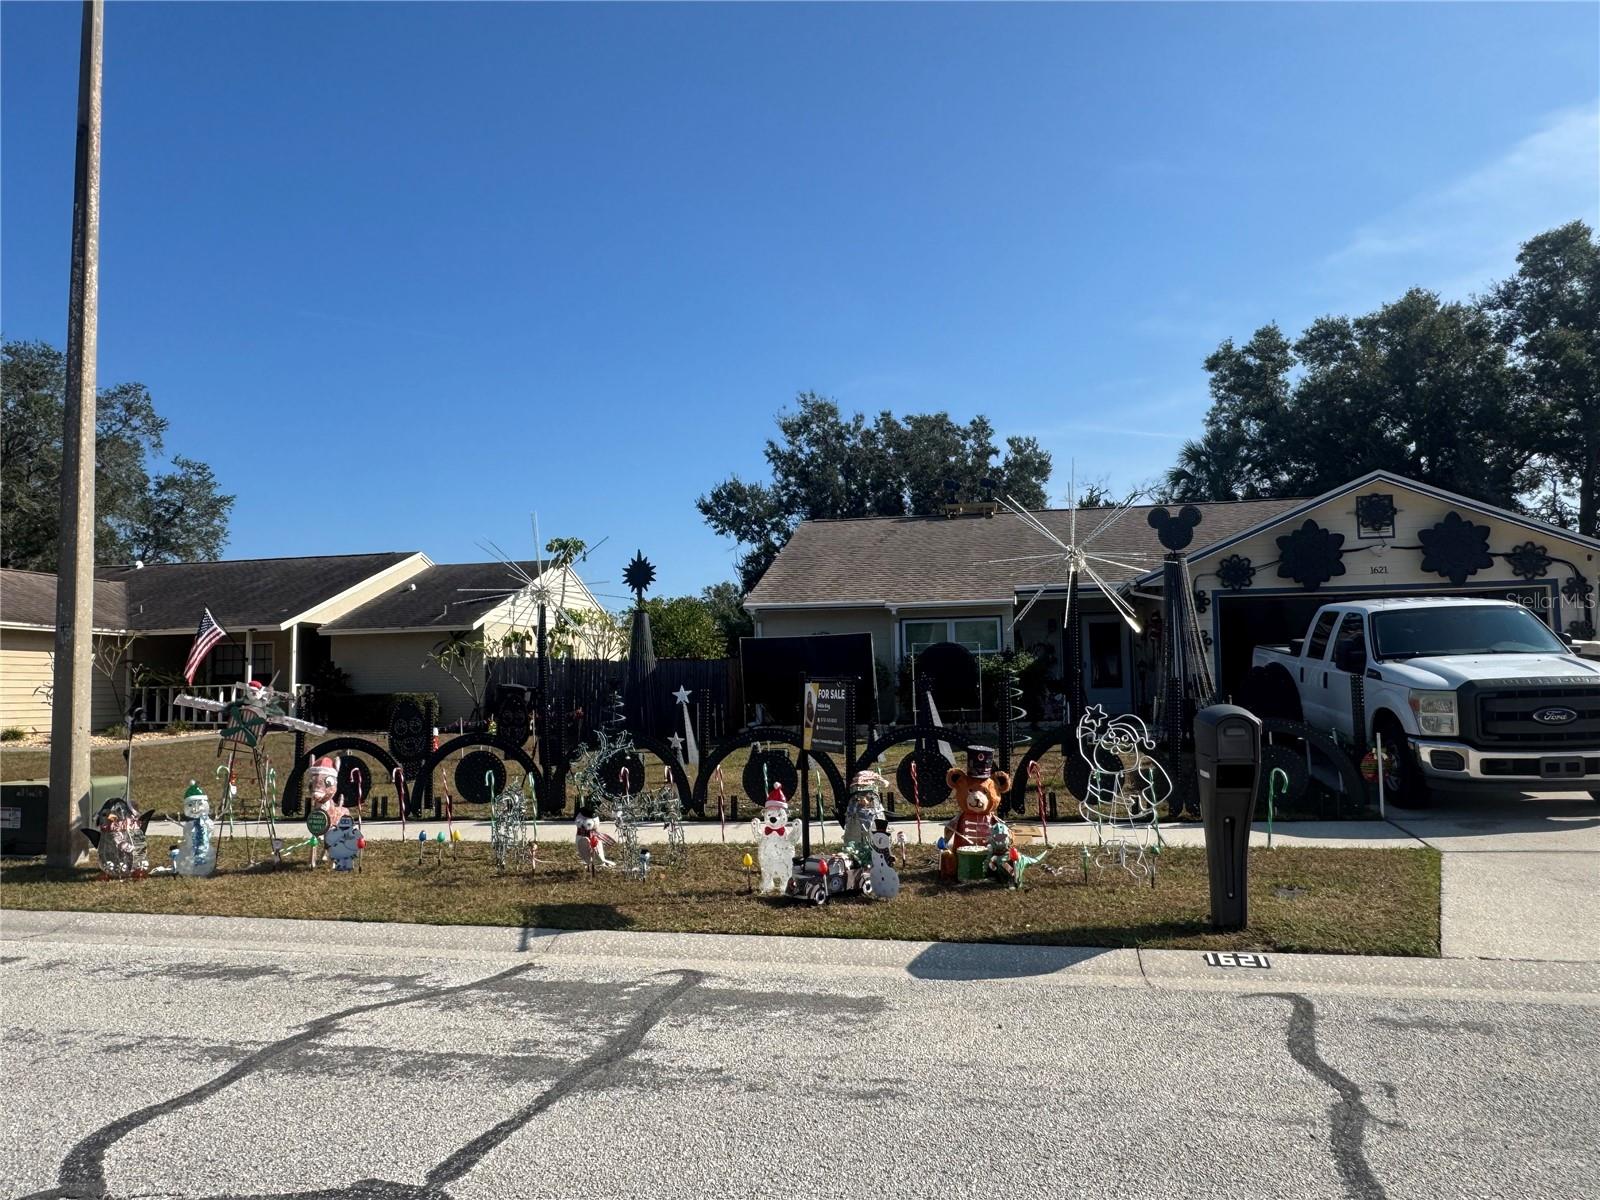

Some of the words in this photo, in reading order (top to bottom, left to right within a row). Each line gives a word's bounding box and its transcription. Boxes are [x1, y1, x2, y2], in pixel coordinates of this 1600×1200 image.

[1370, 566, 1389, 575] 1621
[818, 689, 830, 699] FOR
[830, 689, 845, 699] SALE
[1544, 710, 1568, 720] Ford
[1206, 952, 1268, 968] 1621
